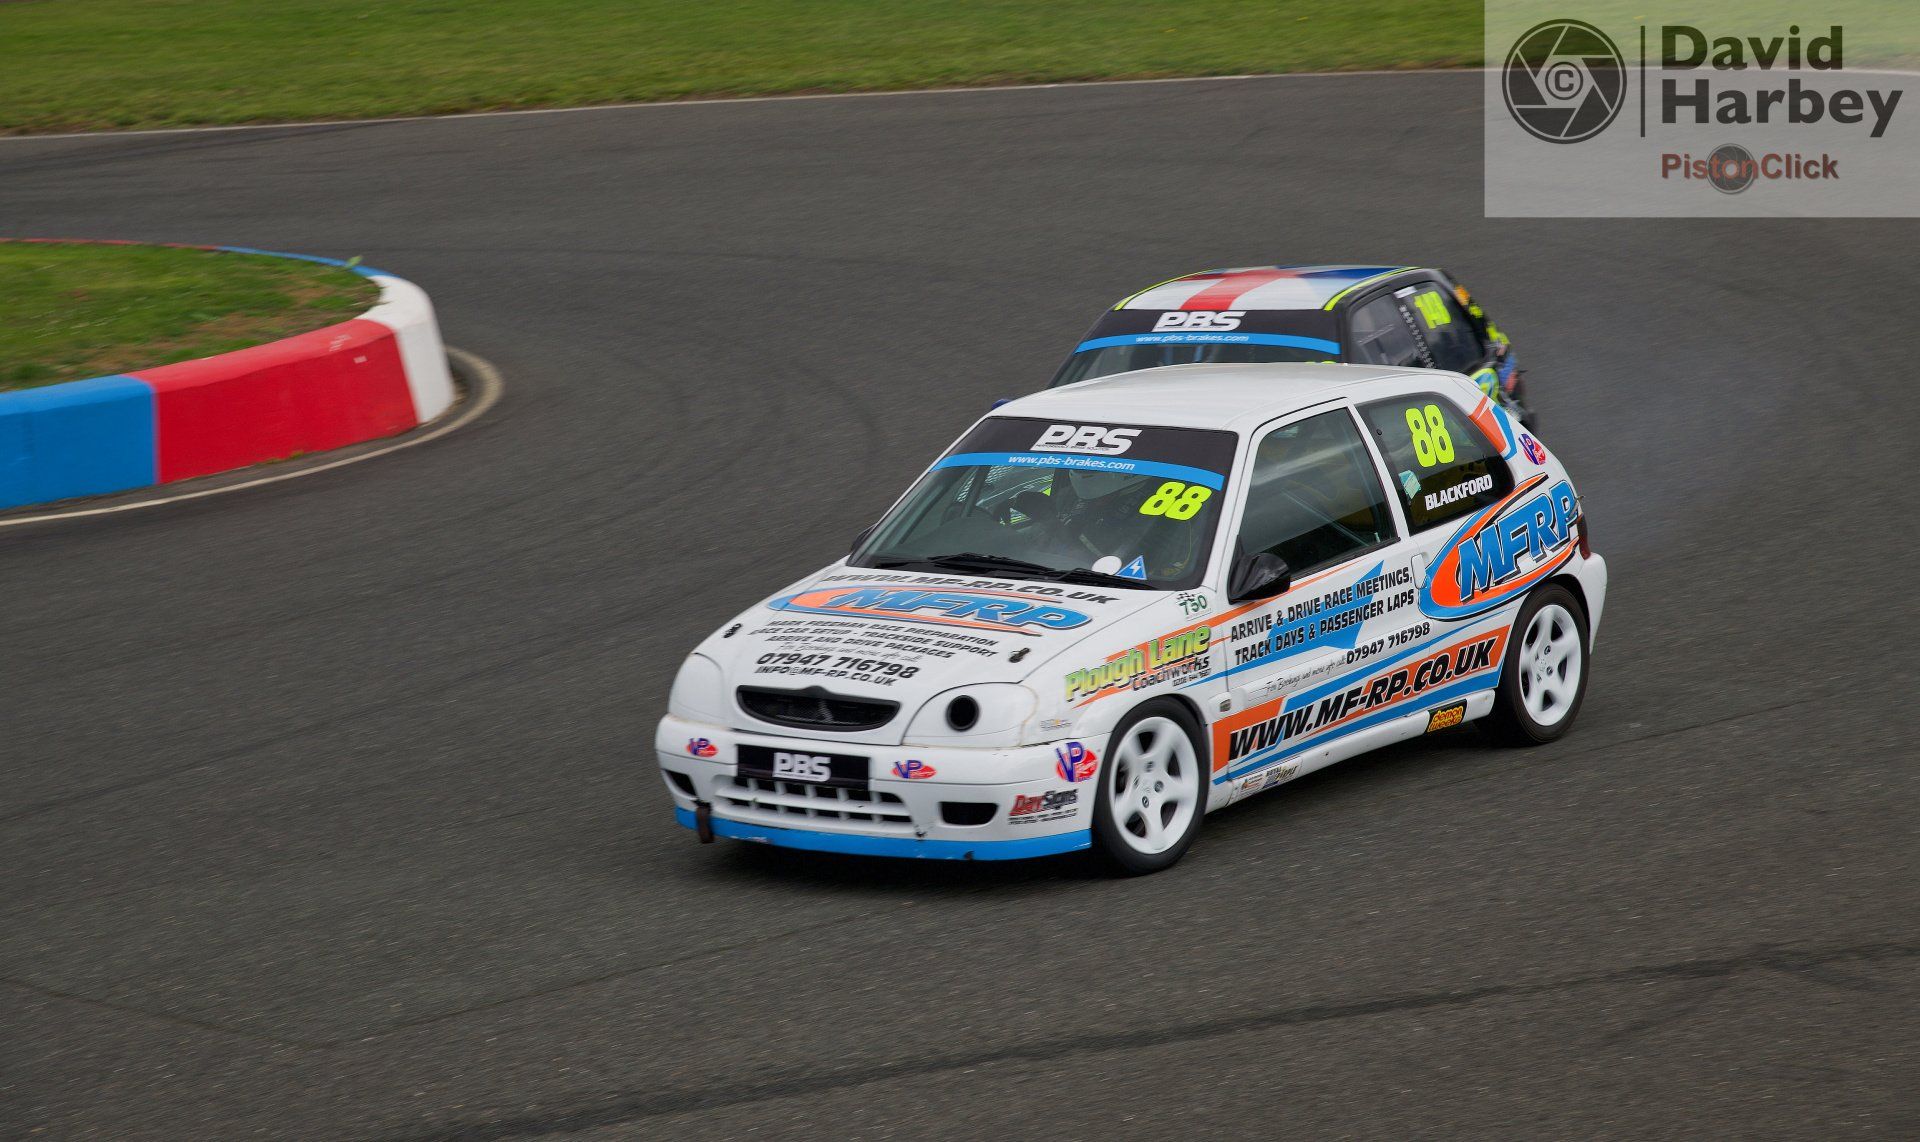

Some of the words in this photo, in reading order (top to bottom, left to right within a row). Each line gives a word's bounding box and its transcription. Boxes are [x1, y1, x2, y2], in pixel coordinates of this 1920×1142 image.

[1151, 311, 1246, 332] PBS
[1031, 425, 1143, 455] PBS
[1405, 405, 1455, 468] 88
[1008, 455, 1135, 471] www.pbs-brakes.com
[1139, 481, 1212, 521] 88
[1424, 474, 1493, 511] BLACKFORD
[1457, 480, 1580, 604] MFRP
[821, 575, 1119, 604] WWW.MF-RP.CO.UK
[1231, 613, 1273, 643] ARRIVE
[1276, 610, 1284, 626] &
[1287, 597, 1321, 623] DRIVE
[1324, 586, 1353, 611] RACE
[1356, 566, 1413, 602] MEETINGS,
[822, 589, 1094, 631] MFRP
[861, 631, 933, 645] TRACKSIDE
[932, 640, 999, 657] SUPPORT
[869, 623, 905, 632] RACE
[904, 627, 999, 647] PREPARATION
[1235, 640, 1273, 666] TRACK
[1275, 628, 1304, 653] DAYS
[1308, 623, 1316, 640] &
[1320, 600, 1384, 636] PASSENGER
[1387, 589, 1414, 612] LAPS
[1346, 638, 1384, 664] 07947
[1387, 621, 1430, 649] 716798
[812, 636, 843, 644] AND
[843, 638, 884, 647] DRIVE
[884, 642, 956, 659] PACKAGES
[1065, 647, 1146, 702] Plough
[1148, 625, 1212, 670] Lane
[754, 665, 896, 686] INFO@MF-RP.CO.UK
[756, 652, 832, 666] 07947
[831, 656, 920, 679] 716798
[1228, 637, 1496, 761] WWW.MF-RP.CO.UK
[772, 752, 831, 782] PBS
[895, 759, 923, 779] VP
[1056, 741, 1084, 783] VP
